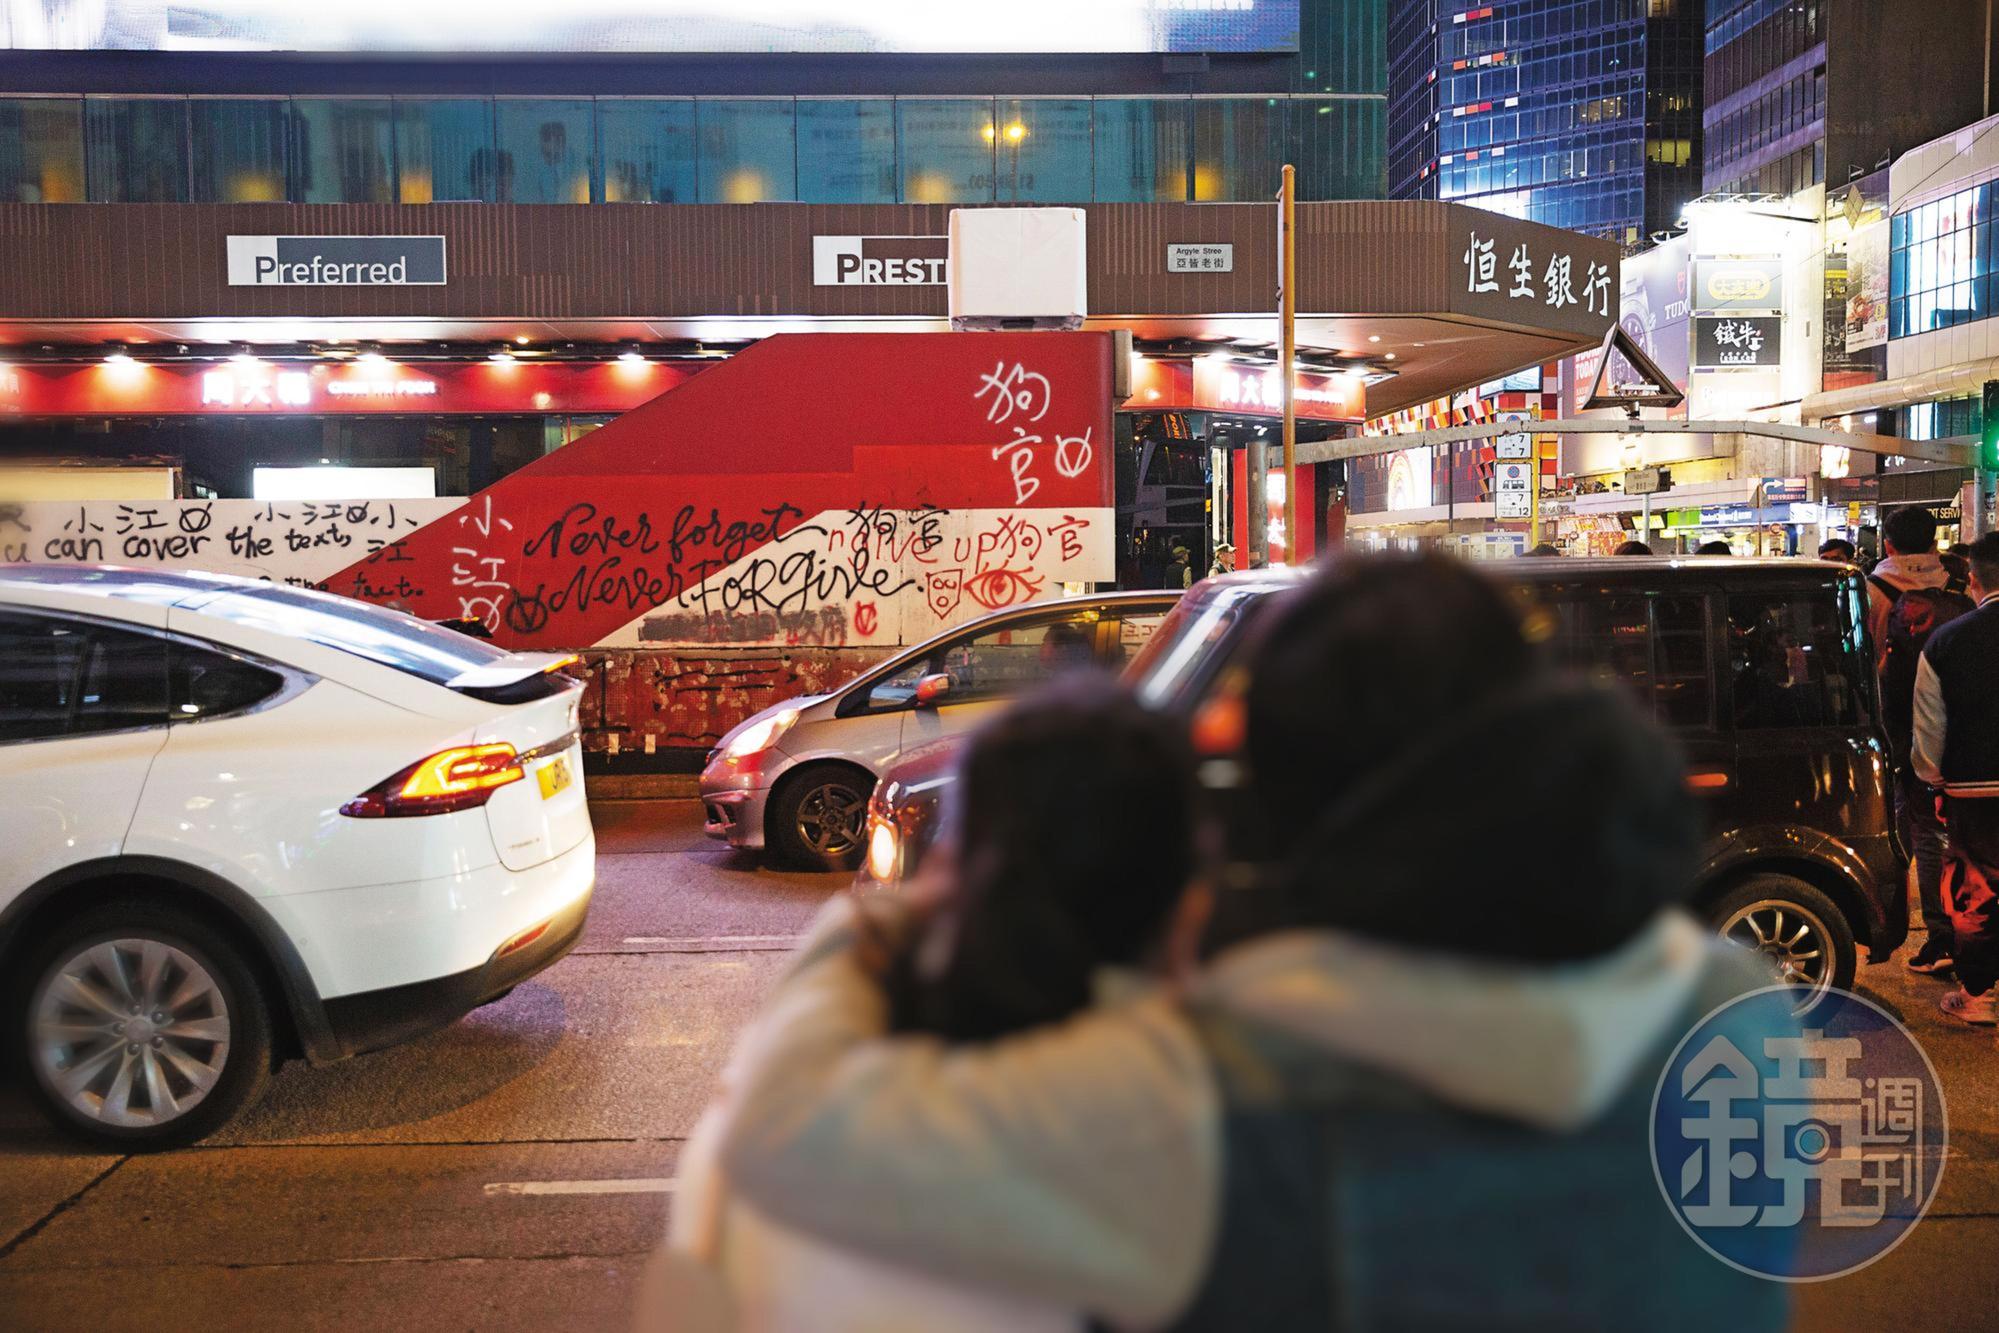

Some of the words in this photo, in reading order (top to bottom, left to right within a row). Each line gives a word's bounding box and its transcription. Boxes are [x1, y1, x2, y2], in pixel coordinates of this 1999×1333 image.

[1176, 247, 1200, 256] Argyle
[1176, 257, 1224, 269] 亞皆老街
[255, 255, 406, 284] Preferred
[1463, 230, 1612, 317] 恒生銀行
[1518, 447, 1525, 456] 7
[1518, 507, 1529, 516] 12
[44, 537, 104, 561] can
[123, 535, 211, 562] cover
[225, 526, 275, 559] the
[523, 503, 660, 559] Never
[667, 503, 829, 565] forget
[550, 556, 690, 613] Never
